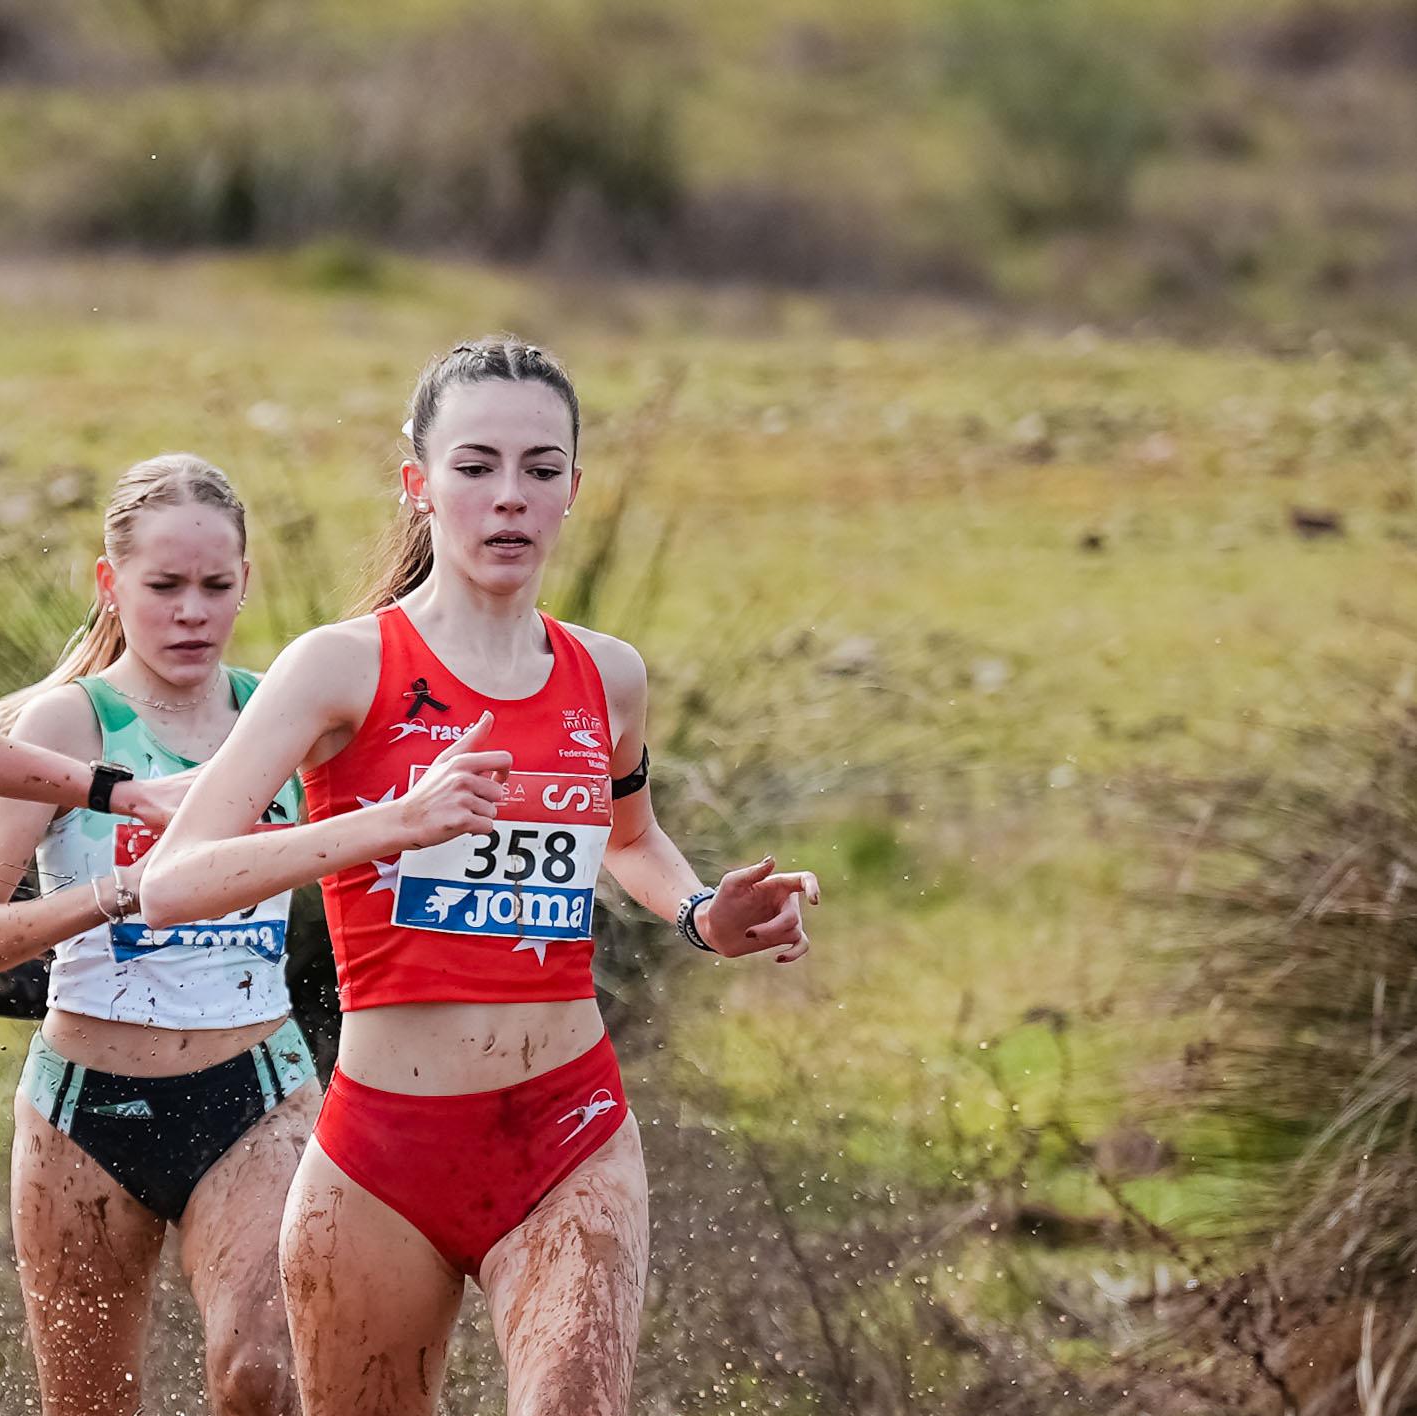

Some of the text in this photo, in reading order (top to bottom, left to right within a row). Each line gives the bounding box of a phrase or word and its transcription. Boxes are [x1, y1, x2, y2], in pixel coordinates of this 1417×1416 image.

[500, 783, 526, 795] SA
[464, 829, 576, 884] 358
[464, 889, 585, 928] Joma
